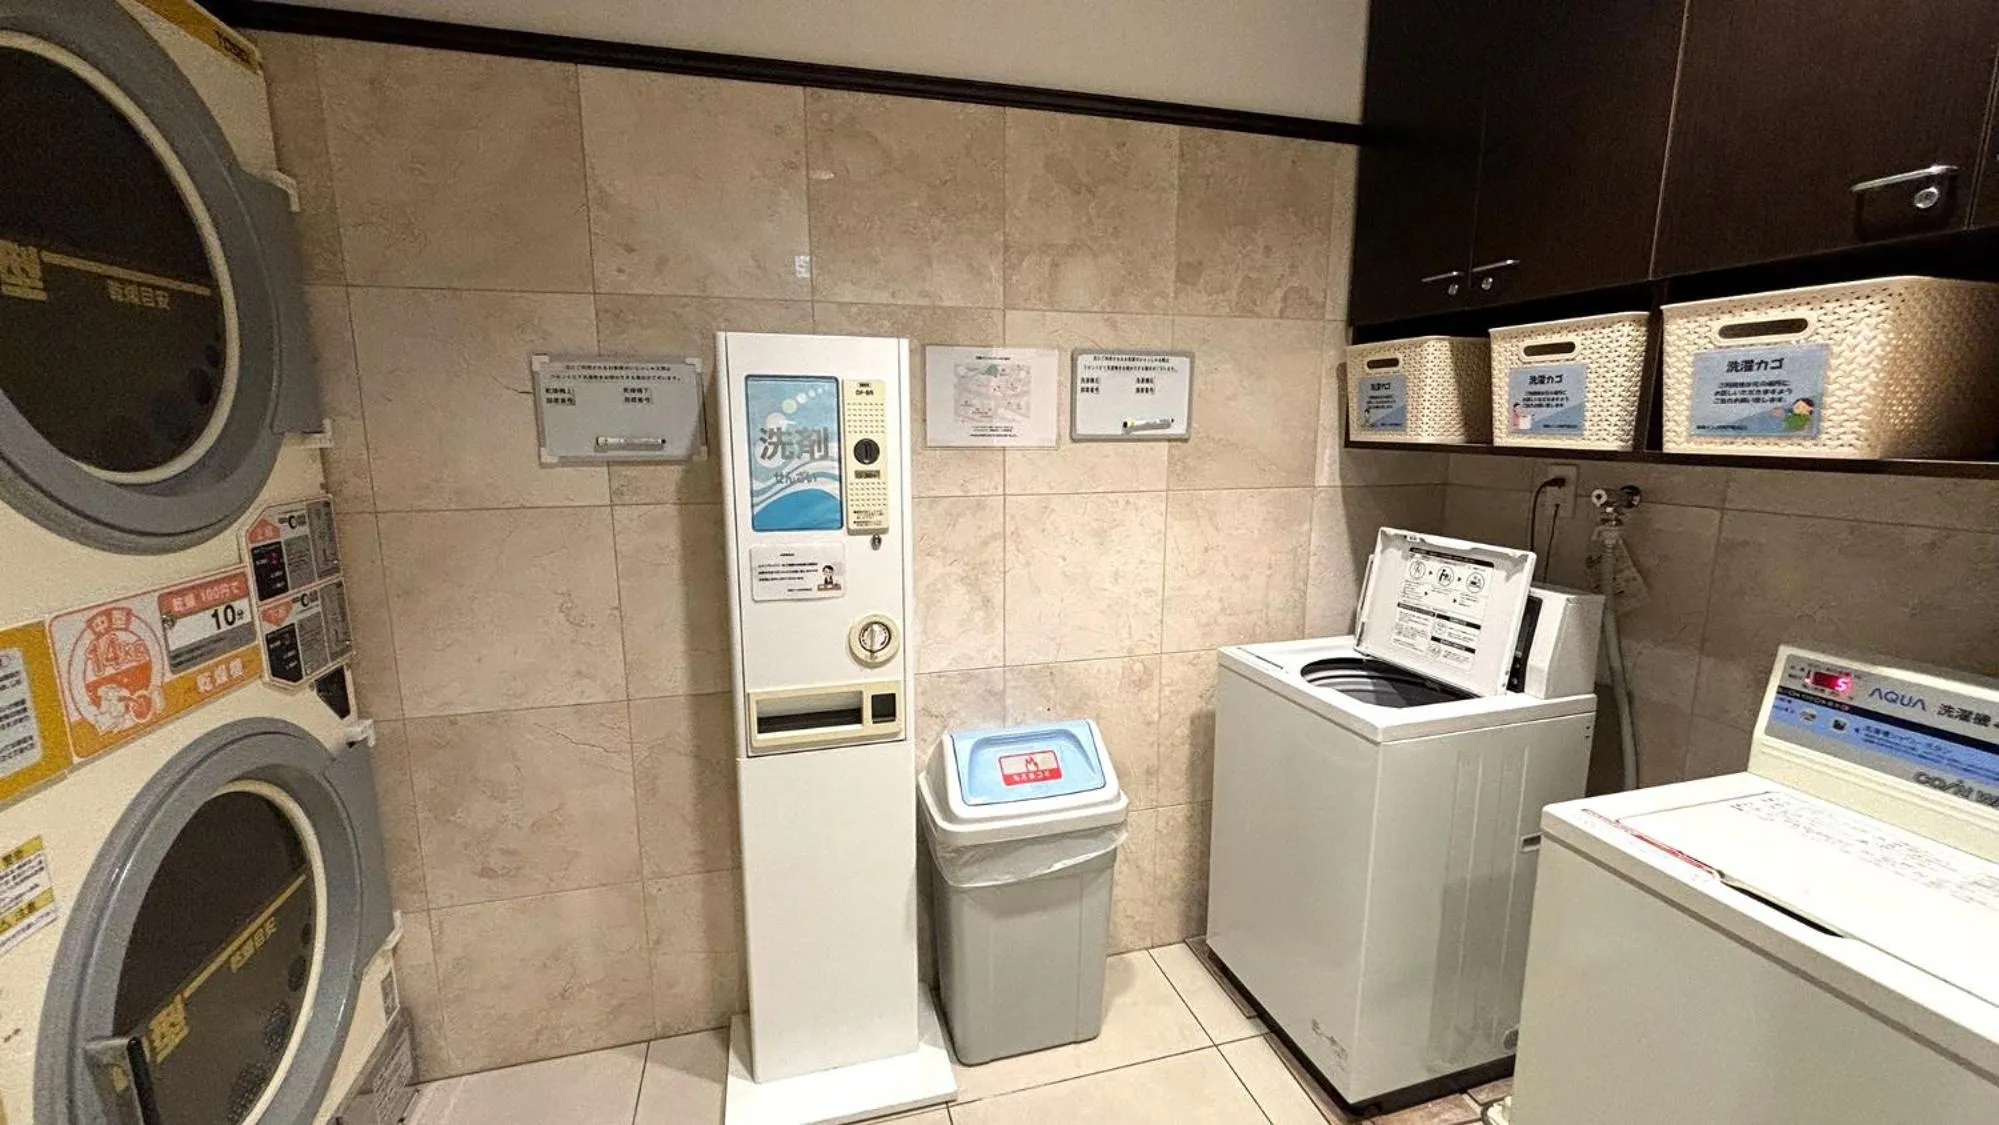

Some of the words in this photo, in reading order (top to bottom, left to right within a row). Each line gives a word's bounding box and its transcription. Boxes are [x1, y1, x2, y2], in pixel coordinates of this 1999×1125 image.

[1726, 357, 1785, 373] 洗濯カゴ
[760, 427, 829, 461] 洗剤
[774, 471, 818, 485] せんざい
[1868, 688, 1927, 712] AQUA
